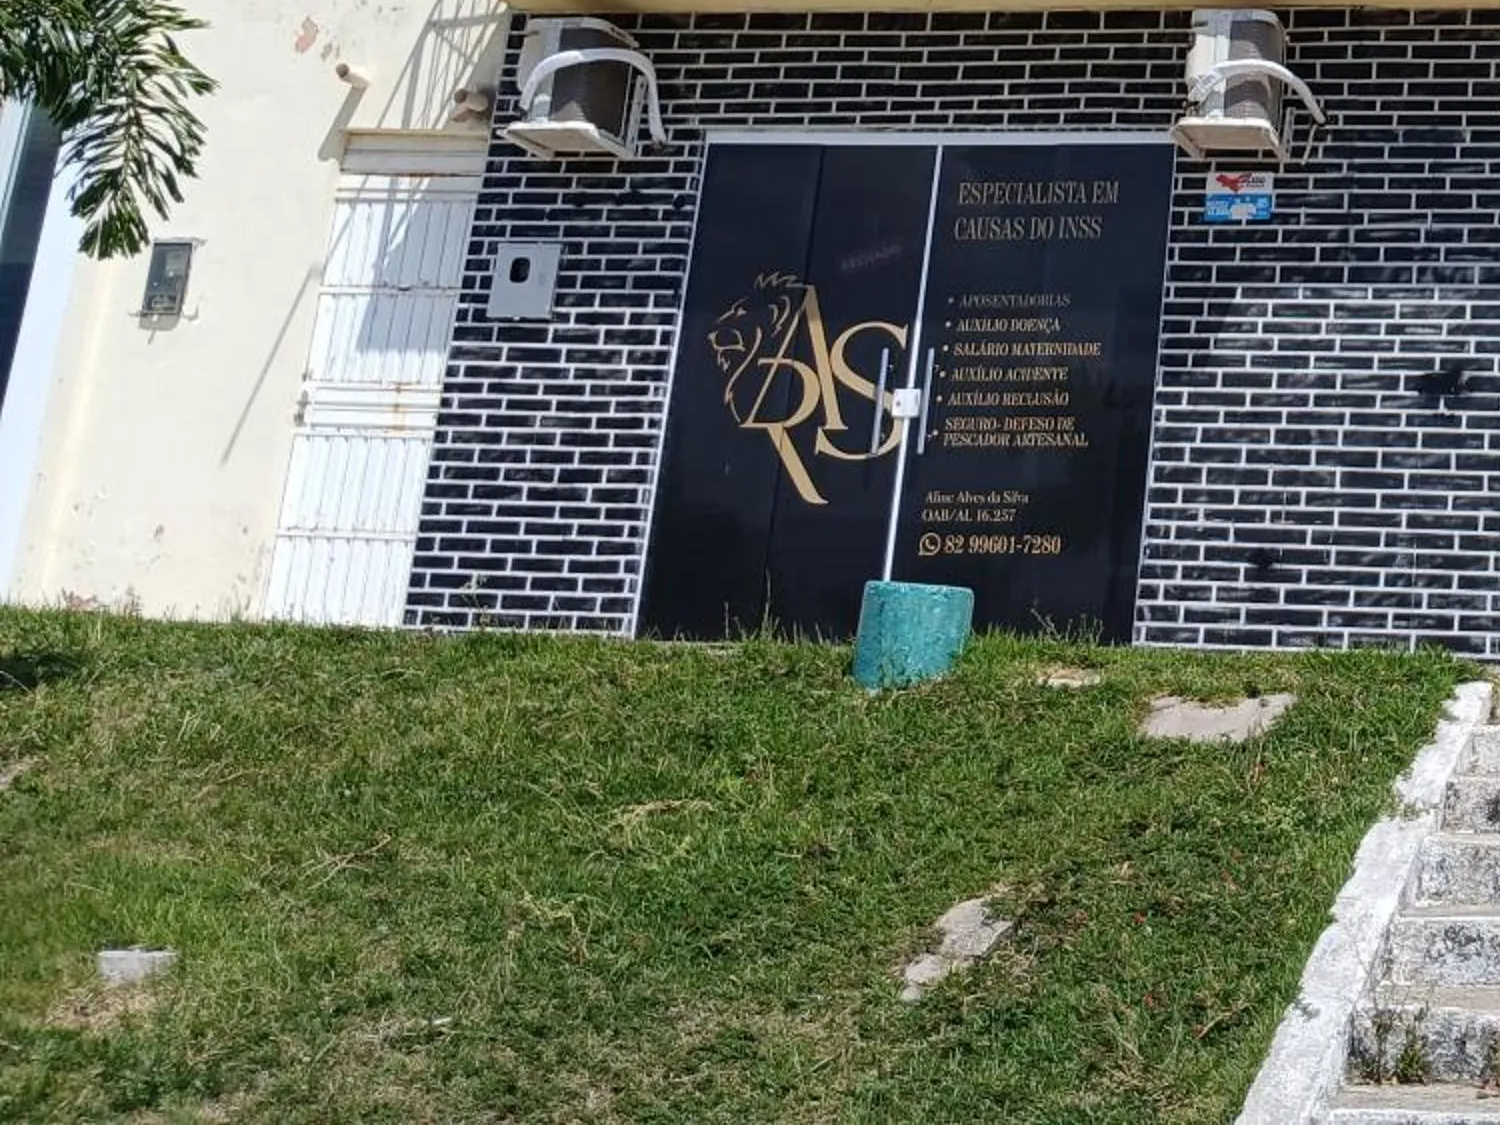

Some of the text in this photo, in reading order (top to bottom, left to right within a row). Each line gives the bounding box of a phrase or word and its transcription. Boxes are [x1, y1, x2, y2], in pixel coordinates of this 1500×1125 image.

[958, 180, 1120, 205] ESPECIALISTA EM
[953, 216, 1102, 241] CAUSAS DO INSS
[959, 293, 1072, 309] APOSENTADORIAS
[1010, 317, 1061, 334] DOENÇA
[953, 339, 1102, 356] SALÁRIO MATERNIDADE
[1004, 366, 1069, 381] ACIDENTE
[1057, 416, 1076, 431] DE
[943, 431, 1089, 447] PESCADOR ARTESANAL
[925, 490, 1029, 504] Aline Alves da Silva
[921, 508, 972, 523] OAB/AL
[944, 534, 1062, 555] 82 99601-7280
